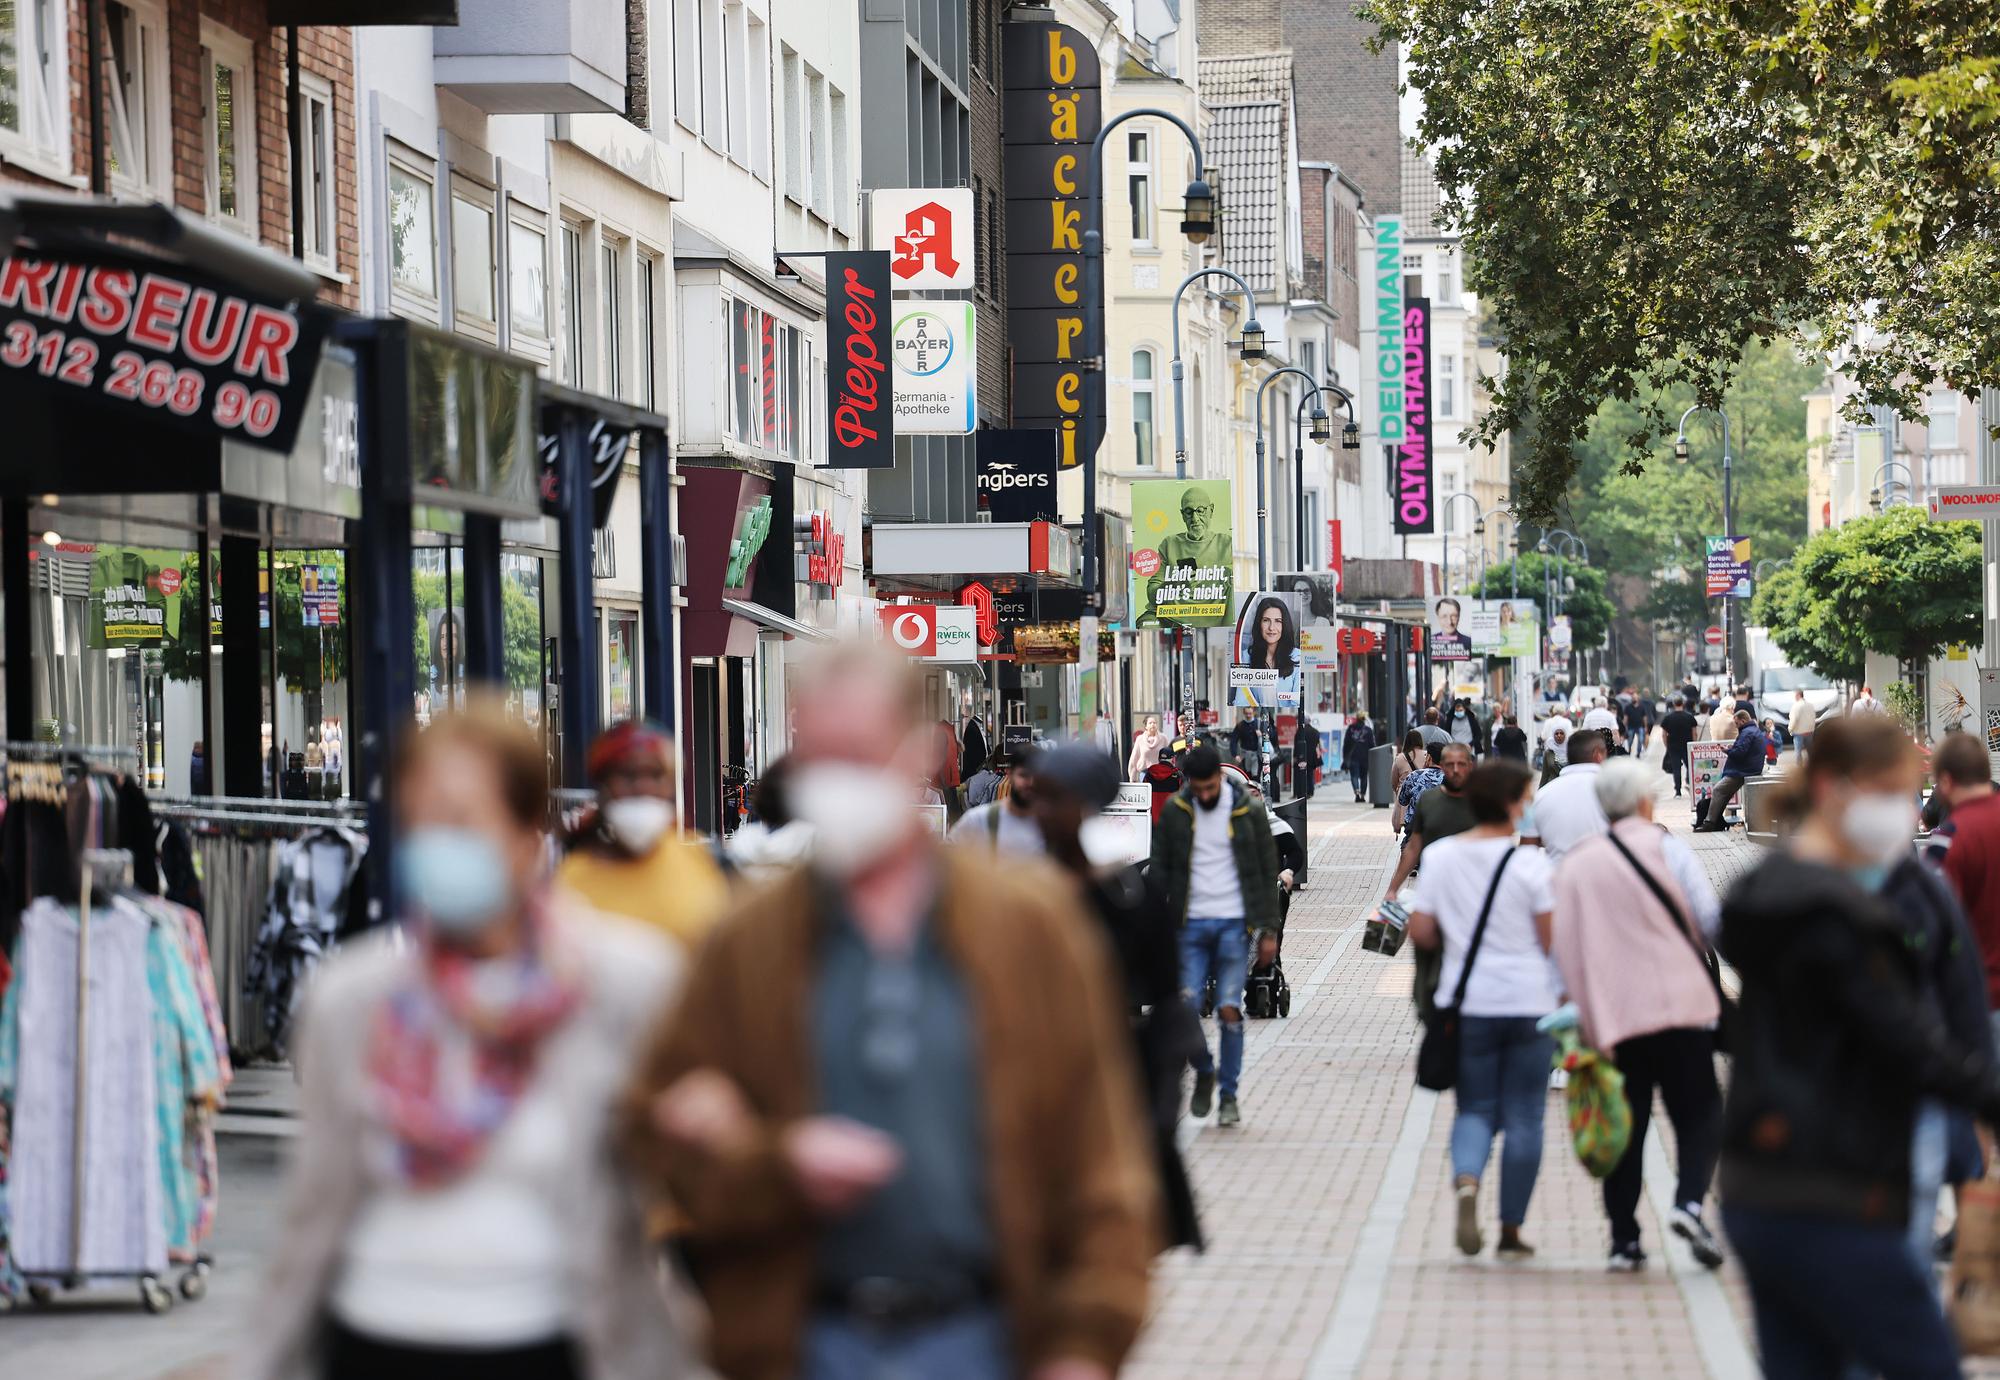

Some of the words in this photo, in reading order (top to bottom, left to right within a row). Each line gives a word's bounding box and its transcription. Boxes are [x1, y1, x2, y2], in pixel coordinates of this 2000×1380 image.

[1048, 31, 1084, 466] bäckerei
[0, 257, 299, 386] RISEUR
[1377, 221, 1402, 439] DEICHMANN
[895, 339, 948, 350] BAYER
[834, 267, 885, 448] Pieper
[0, 320, 99, 387] 312
[104, 351, 205, 416] 268
[212, 380, 281, 437] 90
[894, 404, 950, 416] Apotheke
[977, 469, 1049, 492] ngbers
[1708, 539, 1735, 551] Volt
[1165, 565, 1192, 581] Lädt
[1195, 565, 1228, 582] nicht,
[1193, 584, 1226, 600] nicht.
[937, 631, 970, 639] RWERK
[1231, 671, 1254, 681] Serap
[1254, 671, 1277, 680] Güler
[1119, 793, 1146, 803] Nails
